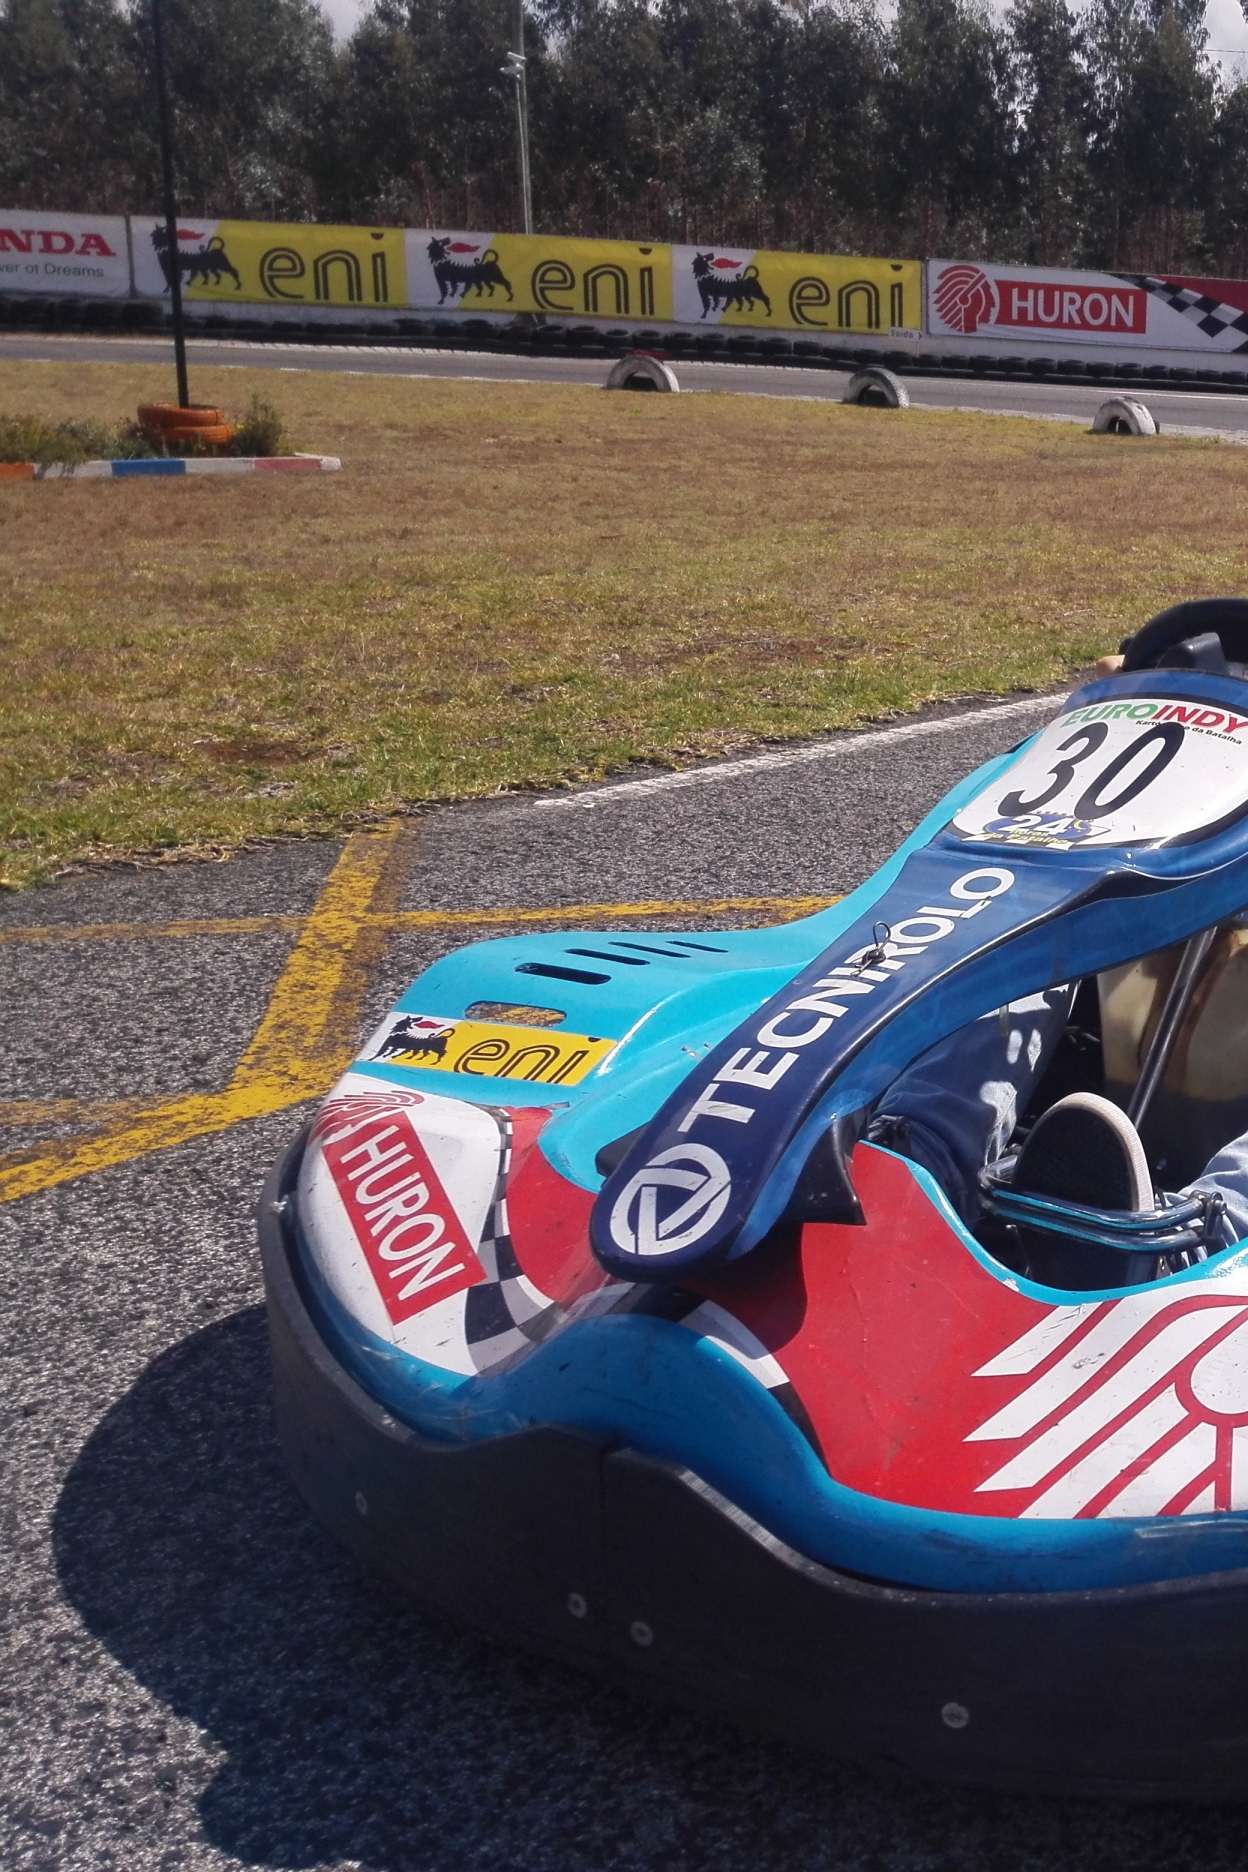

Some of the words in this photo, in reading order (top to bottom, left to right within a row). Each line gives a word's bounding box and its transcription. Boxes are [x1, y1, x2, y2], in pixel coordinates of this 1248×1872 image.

[45, 263, 105, 278] Dreams
[259, 232, 389, 303] eni
[531, 247, 655, 316] eni
[788, 263, 904, 329] eni
[1011, 288, 1135, 328] HURON
[1206, 728, 1243, 746] Batalha
[998, 721, 1187, 821] 30
[678, 867, 1016, 1134] TECNIROLO
[453, 1036, 602, 1085] eni
[340, 1123, 466, 1302] HURON
